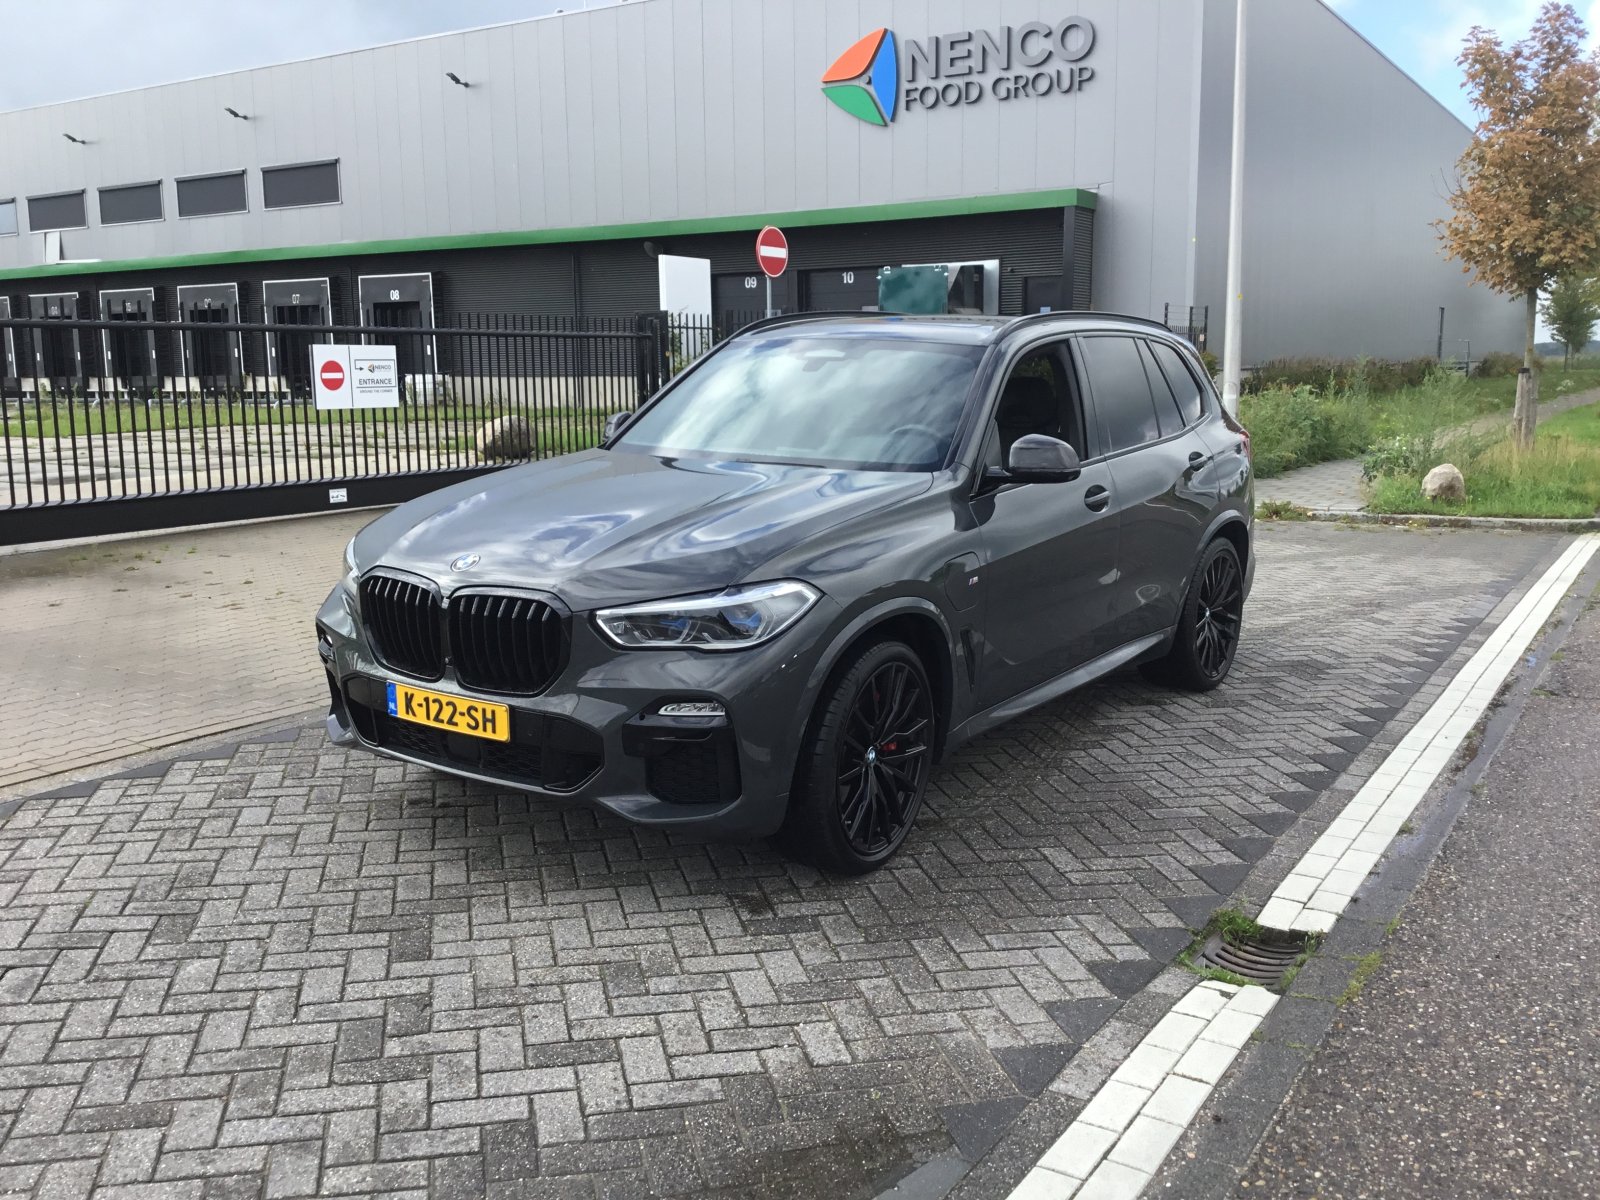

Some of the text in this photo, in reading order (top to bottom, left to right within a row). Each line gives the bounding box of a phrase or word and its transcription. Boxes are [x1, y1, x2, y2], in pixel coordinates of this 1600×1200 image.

[904, 15, 1096, 82] NENCO
[904, 66, 1096, 111] FOOD GROUP
[744, 276, 757, 288] 09
[842, 271, 855, 284] 10
[390, 289, 400, 301] 08
[388, 701, 397, 711] NL
[404, 691, 497, 735] K-122-SH
